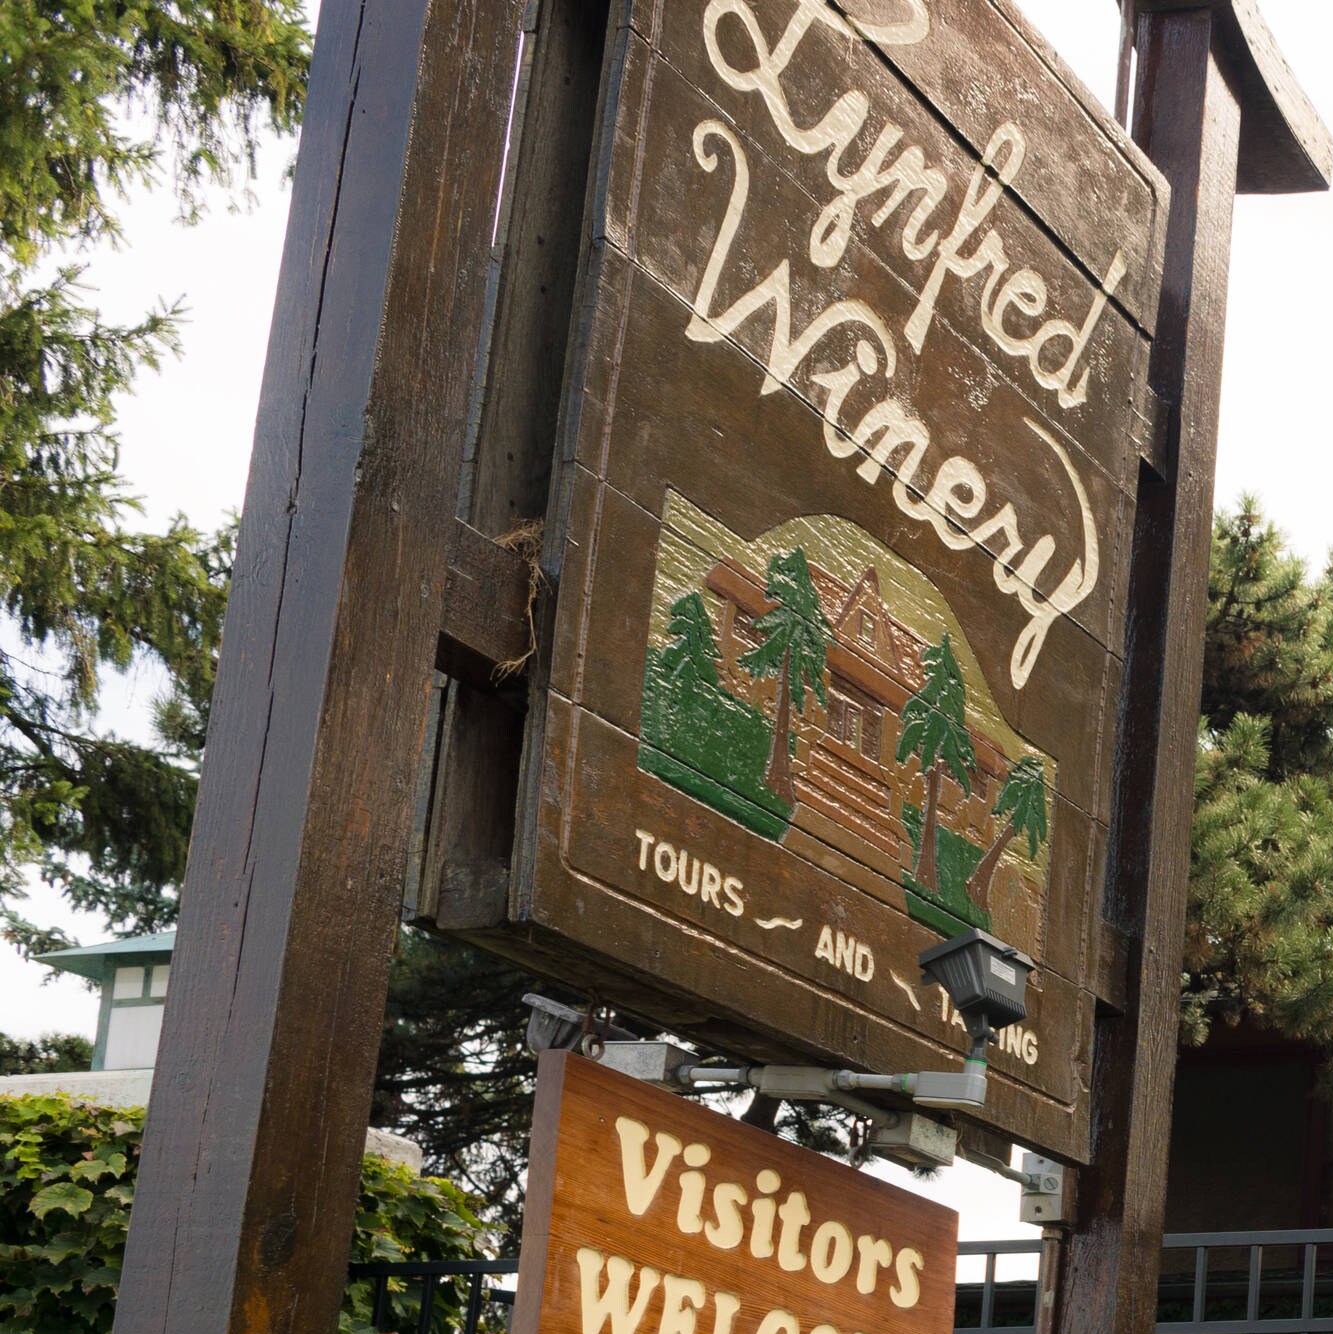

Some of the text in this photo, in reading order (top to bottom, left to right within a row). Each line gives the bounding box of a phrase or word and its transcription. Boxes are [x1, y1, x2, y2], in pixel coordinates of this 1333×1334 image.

[702, 0, 1127, 408] Lynfred
[684, 120, 1100, 691] Winery
[635, 829, 1040, 1066] TOURS AND TAING
[615, 1116, 924, 1308] Visitors
